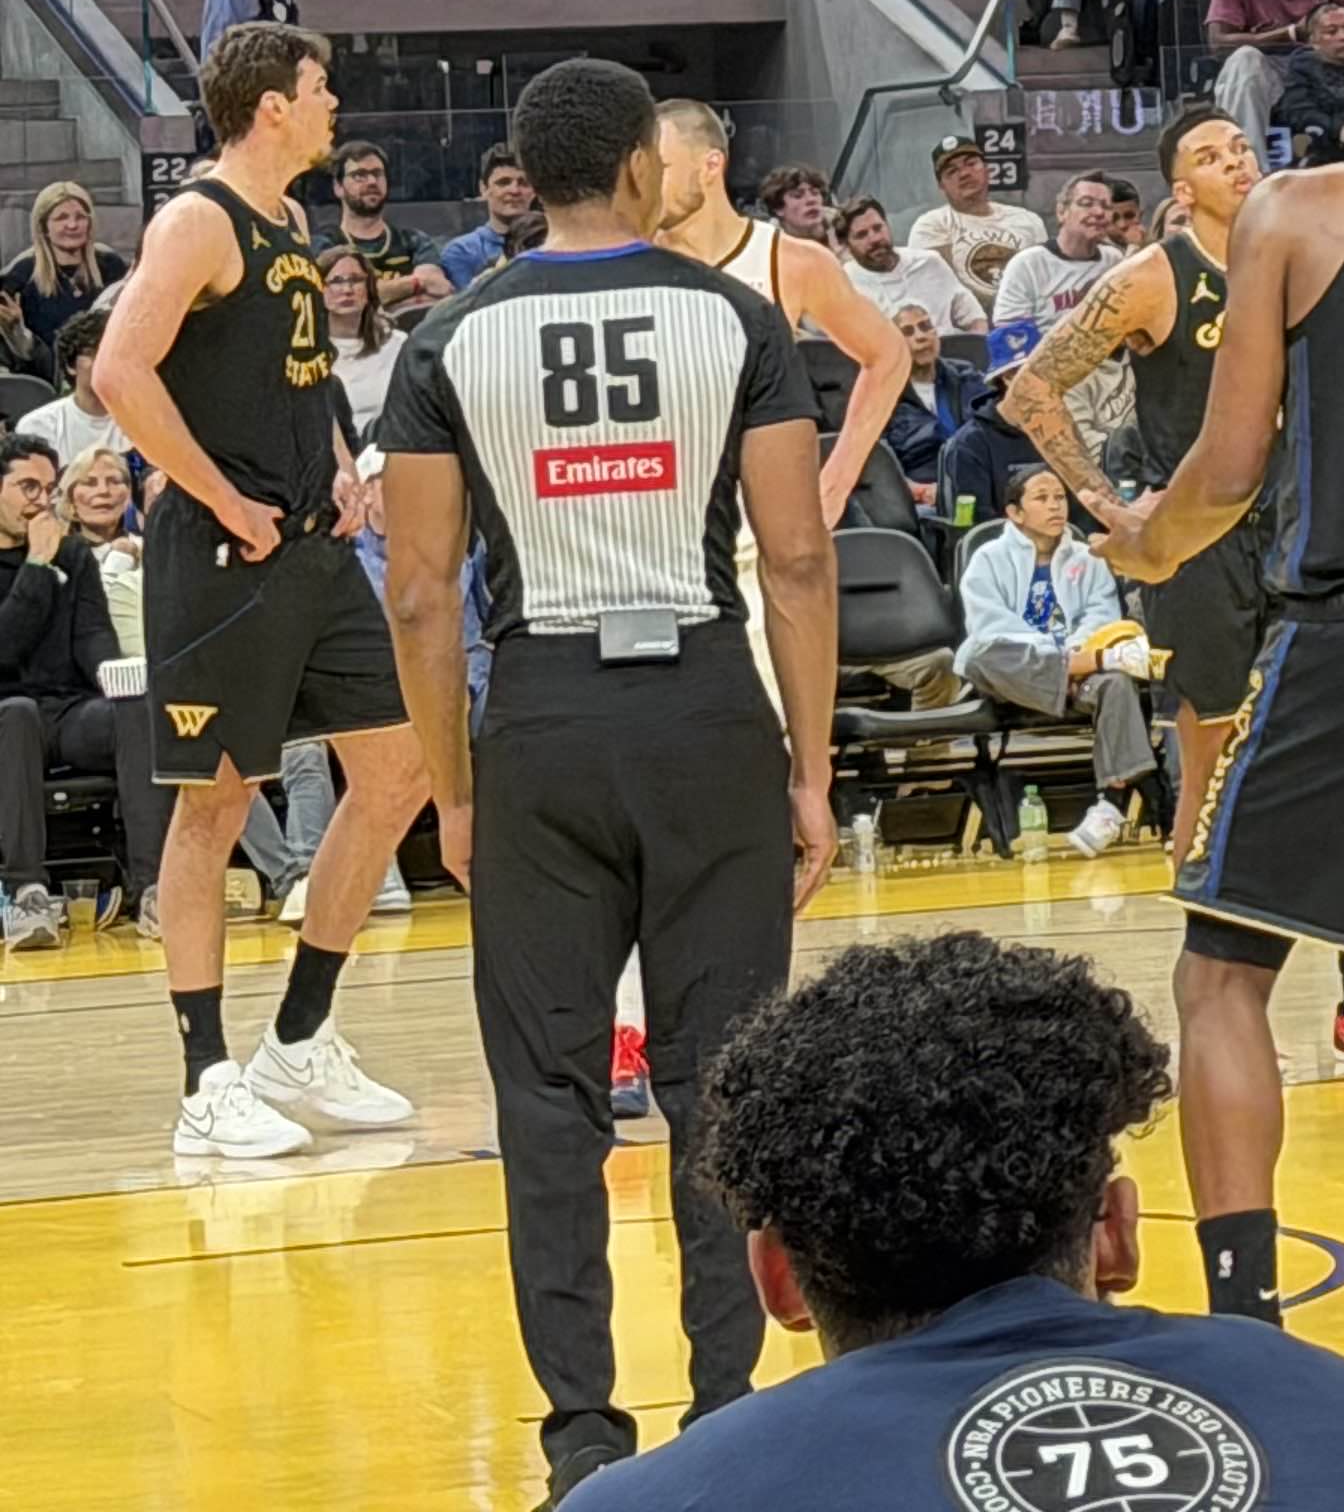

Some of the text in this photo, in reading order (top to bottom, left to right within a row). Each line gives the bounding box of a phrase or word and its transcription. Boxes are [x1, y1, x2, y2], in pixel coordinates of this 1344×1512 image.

[984, 130, 1016, 153] 24
[152, 157, 187, 182] 22
[987, 162, 1017, 185] 23
[290, 290, 316, 350] 21
[539, 315, 662, 428] 85
[547, 456, 664, 486] Emirates
[962, 1376, 1224, 1463] NBA PIONEERS 1950
[964, 1470, 1024, 1512] COO
[1038, 1433, 1170, 1500] 75
[1210, 1441, 1250, 1510] LLOYD
